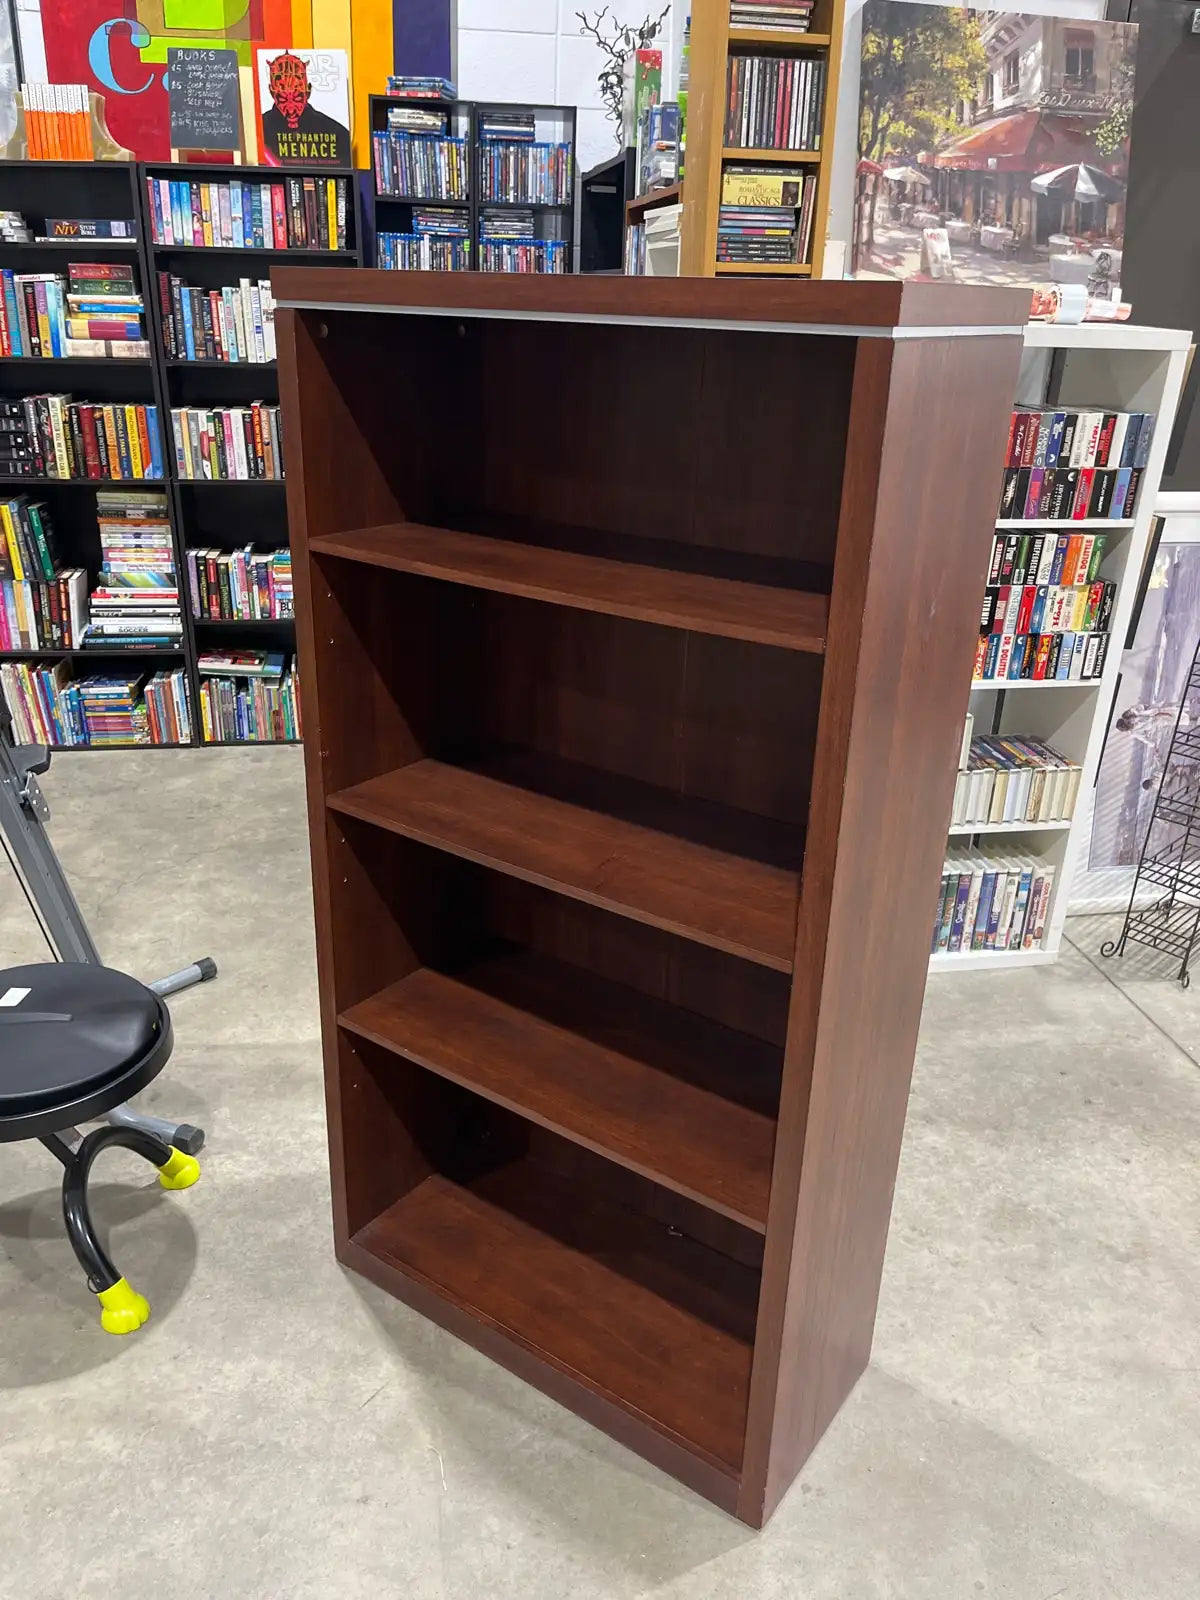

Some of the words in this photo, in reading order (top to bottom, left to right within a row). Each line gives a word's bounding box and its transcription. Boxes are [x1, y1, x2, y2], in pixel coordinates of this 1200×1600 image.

[178, 50, 216, 60] BOOKS
[277, 133, 292, 142] THE
[296, 133, 337, 142] PHANTOM
[278, 143, 337, 158] MENACE
[737, 196, 780, 206] CLASSICS
[54, 224, 78, 235] NIV
[116, 409, 125, 437] NICHOLAS
[98, 437, 107, 465] PATTERSON
[1014, 432, 1024, 457] Crucible
[1088, 425, 1099, 456] NUTTY
[1129, 472, 1138, 494] ANGEL
[1124, 494, 1134, 517] HEART
[1006, 545, 1016, 562] True
[1028, 538, 1043, 575] INDEPENDENCE
[1079, 538, 1093, 570] DOLITTLE
[1076, 571, 1085, 583] DR.
[1052, 596, 1064, 628] Hook
[1002, 636, 1012, 649] DR.
[996, 649, 1010, 678] DOLITTLE
